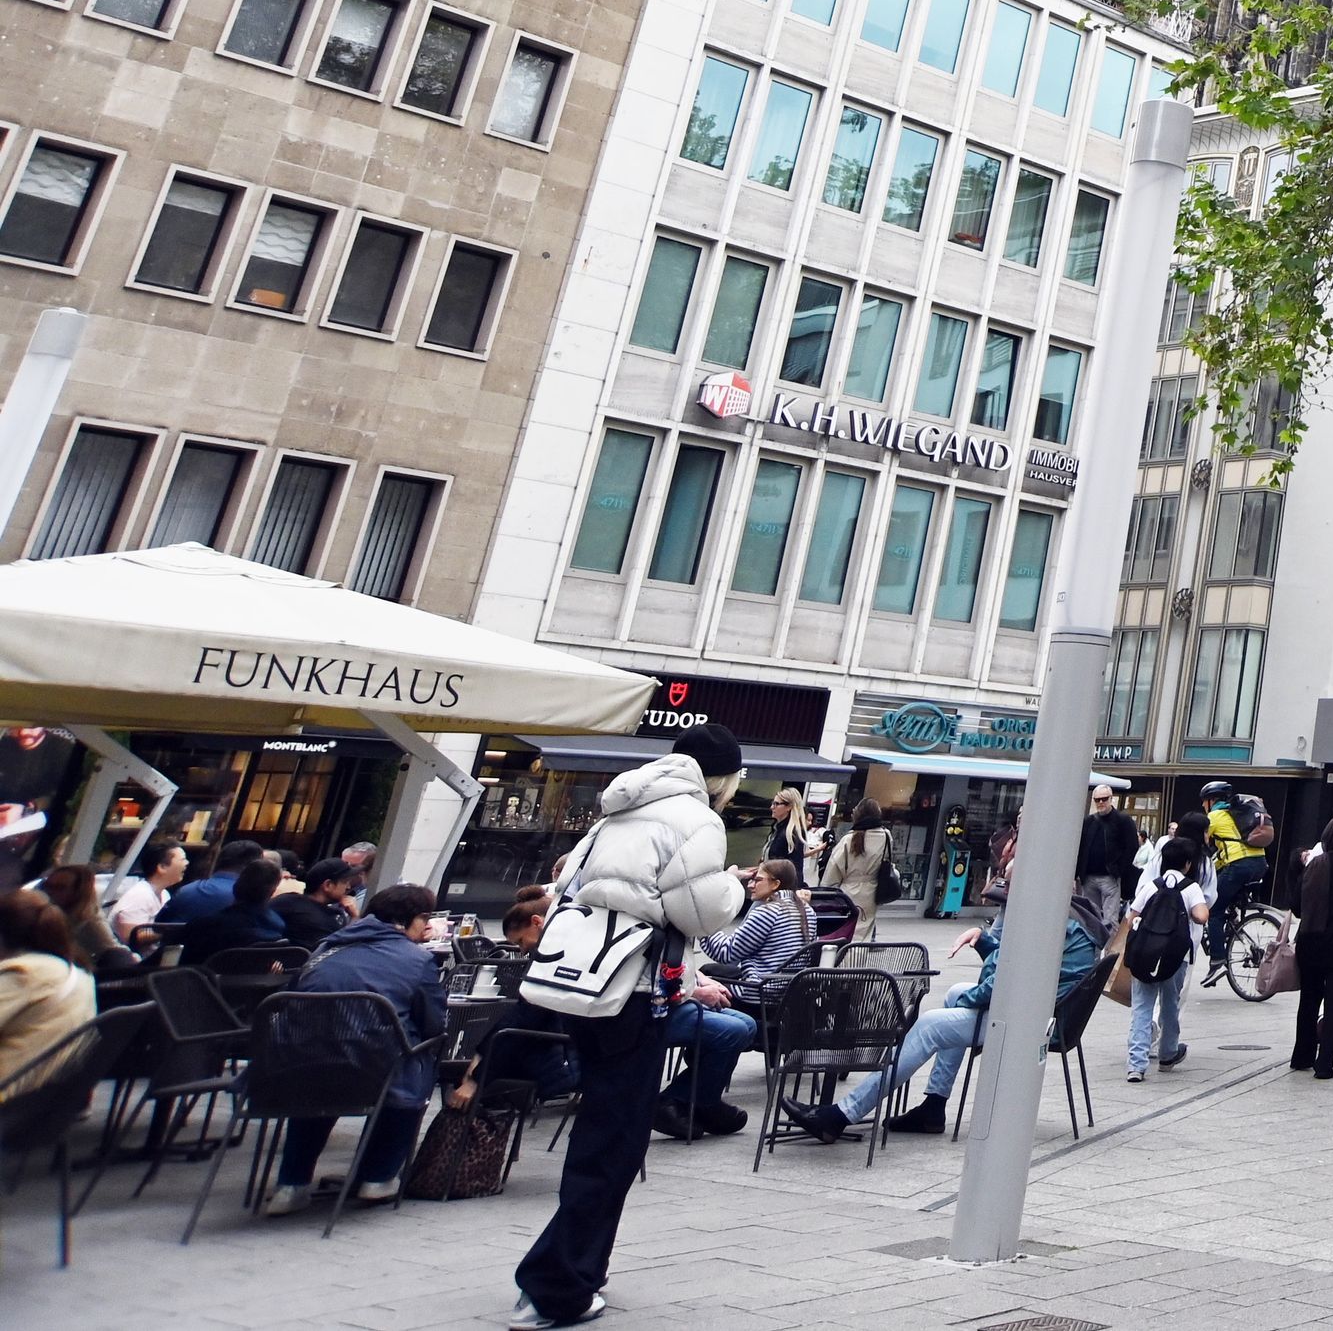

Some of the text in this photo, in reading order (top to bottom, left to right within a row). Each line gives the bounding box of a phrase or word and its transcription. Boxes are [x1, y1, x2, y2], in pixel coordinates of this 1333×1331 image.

[1030, 449, 1079, 474] IMMOBI
[192, 646, 464, 708] FUNKHAUS
[993, 717, 1037, 735] ORIGI
[263, 741, 329, 753] MONTBLANC
[1093, 746, 1132, 760] HAMP
